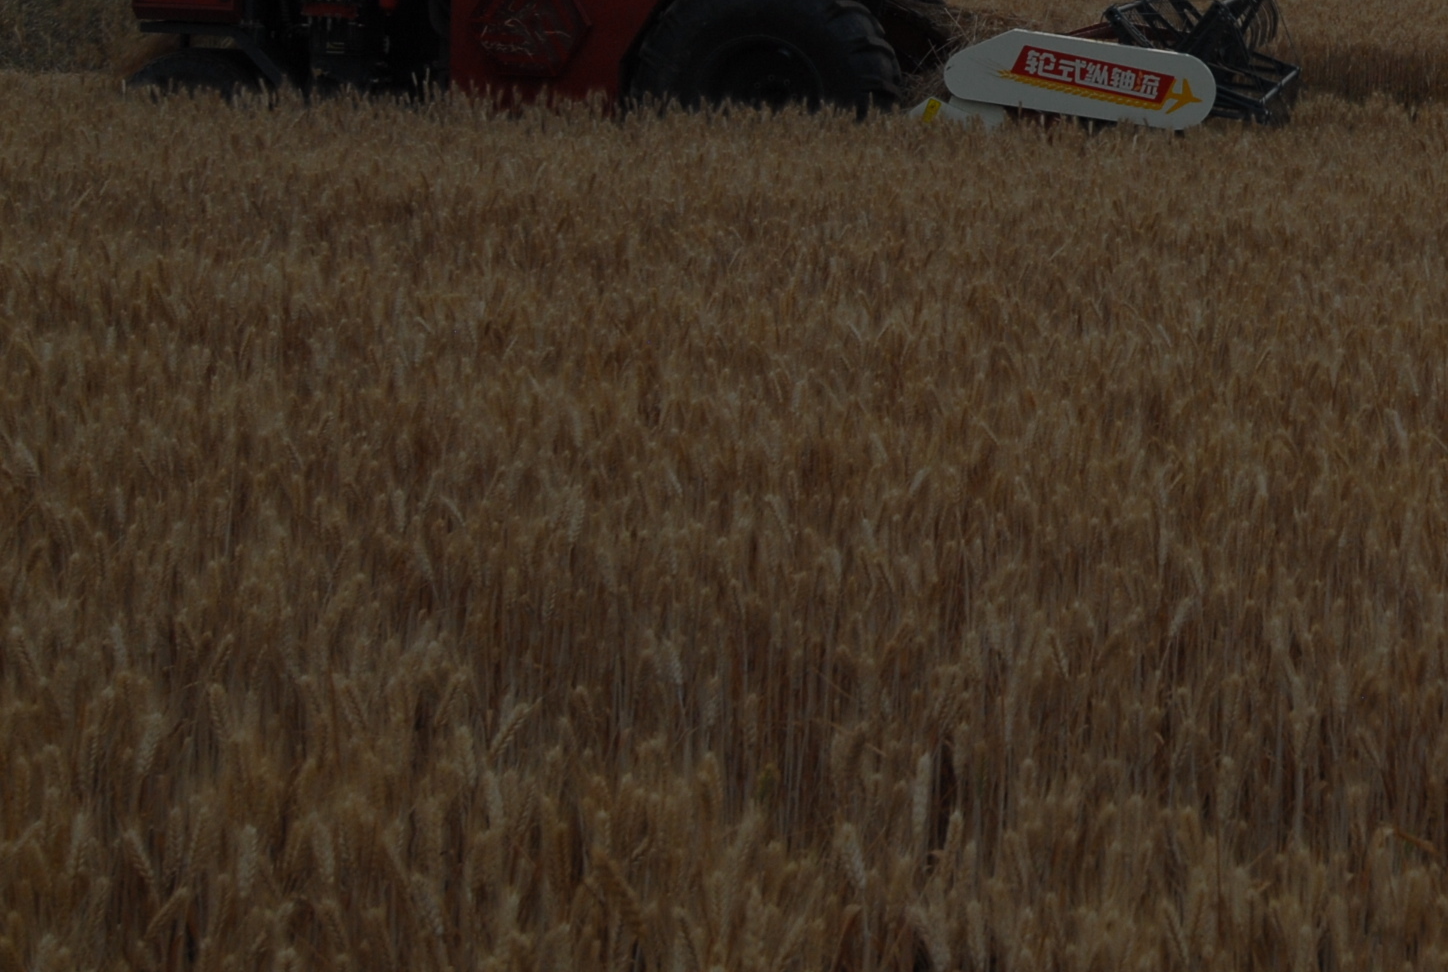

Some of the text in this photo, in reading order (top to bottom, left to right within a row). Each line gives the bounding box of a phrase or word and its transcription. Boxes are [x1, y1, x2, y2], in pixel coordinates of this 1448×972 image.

[1025, 49, 1162, 100] 轮式纵轴流
